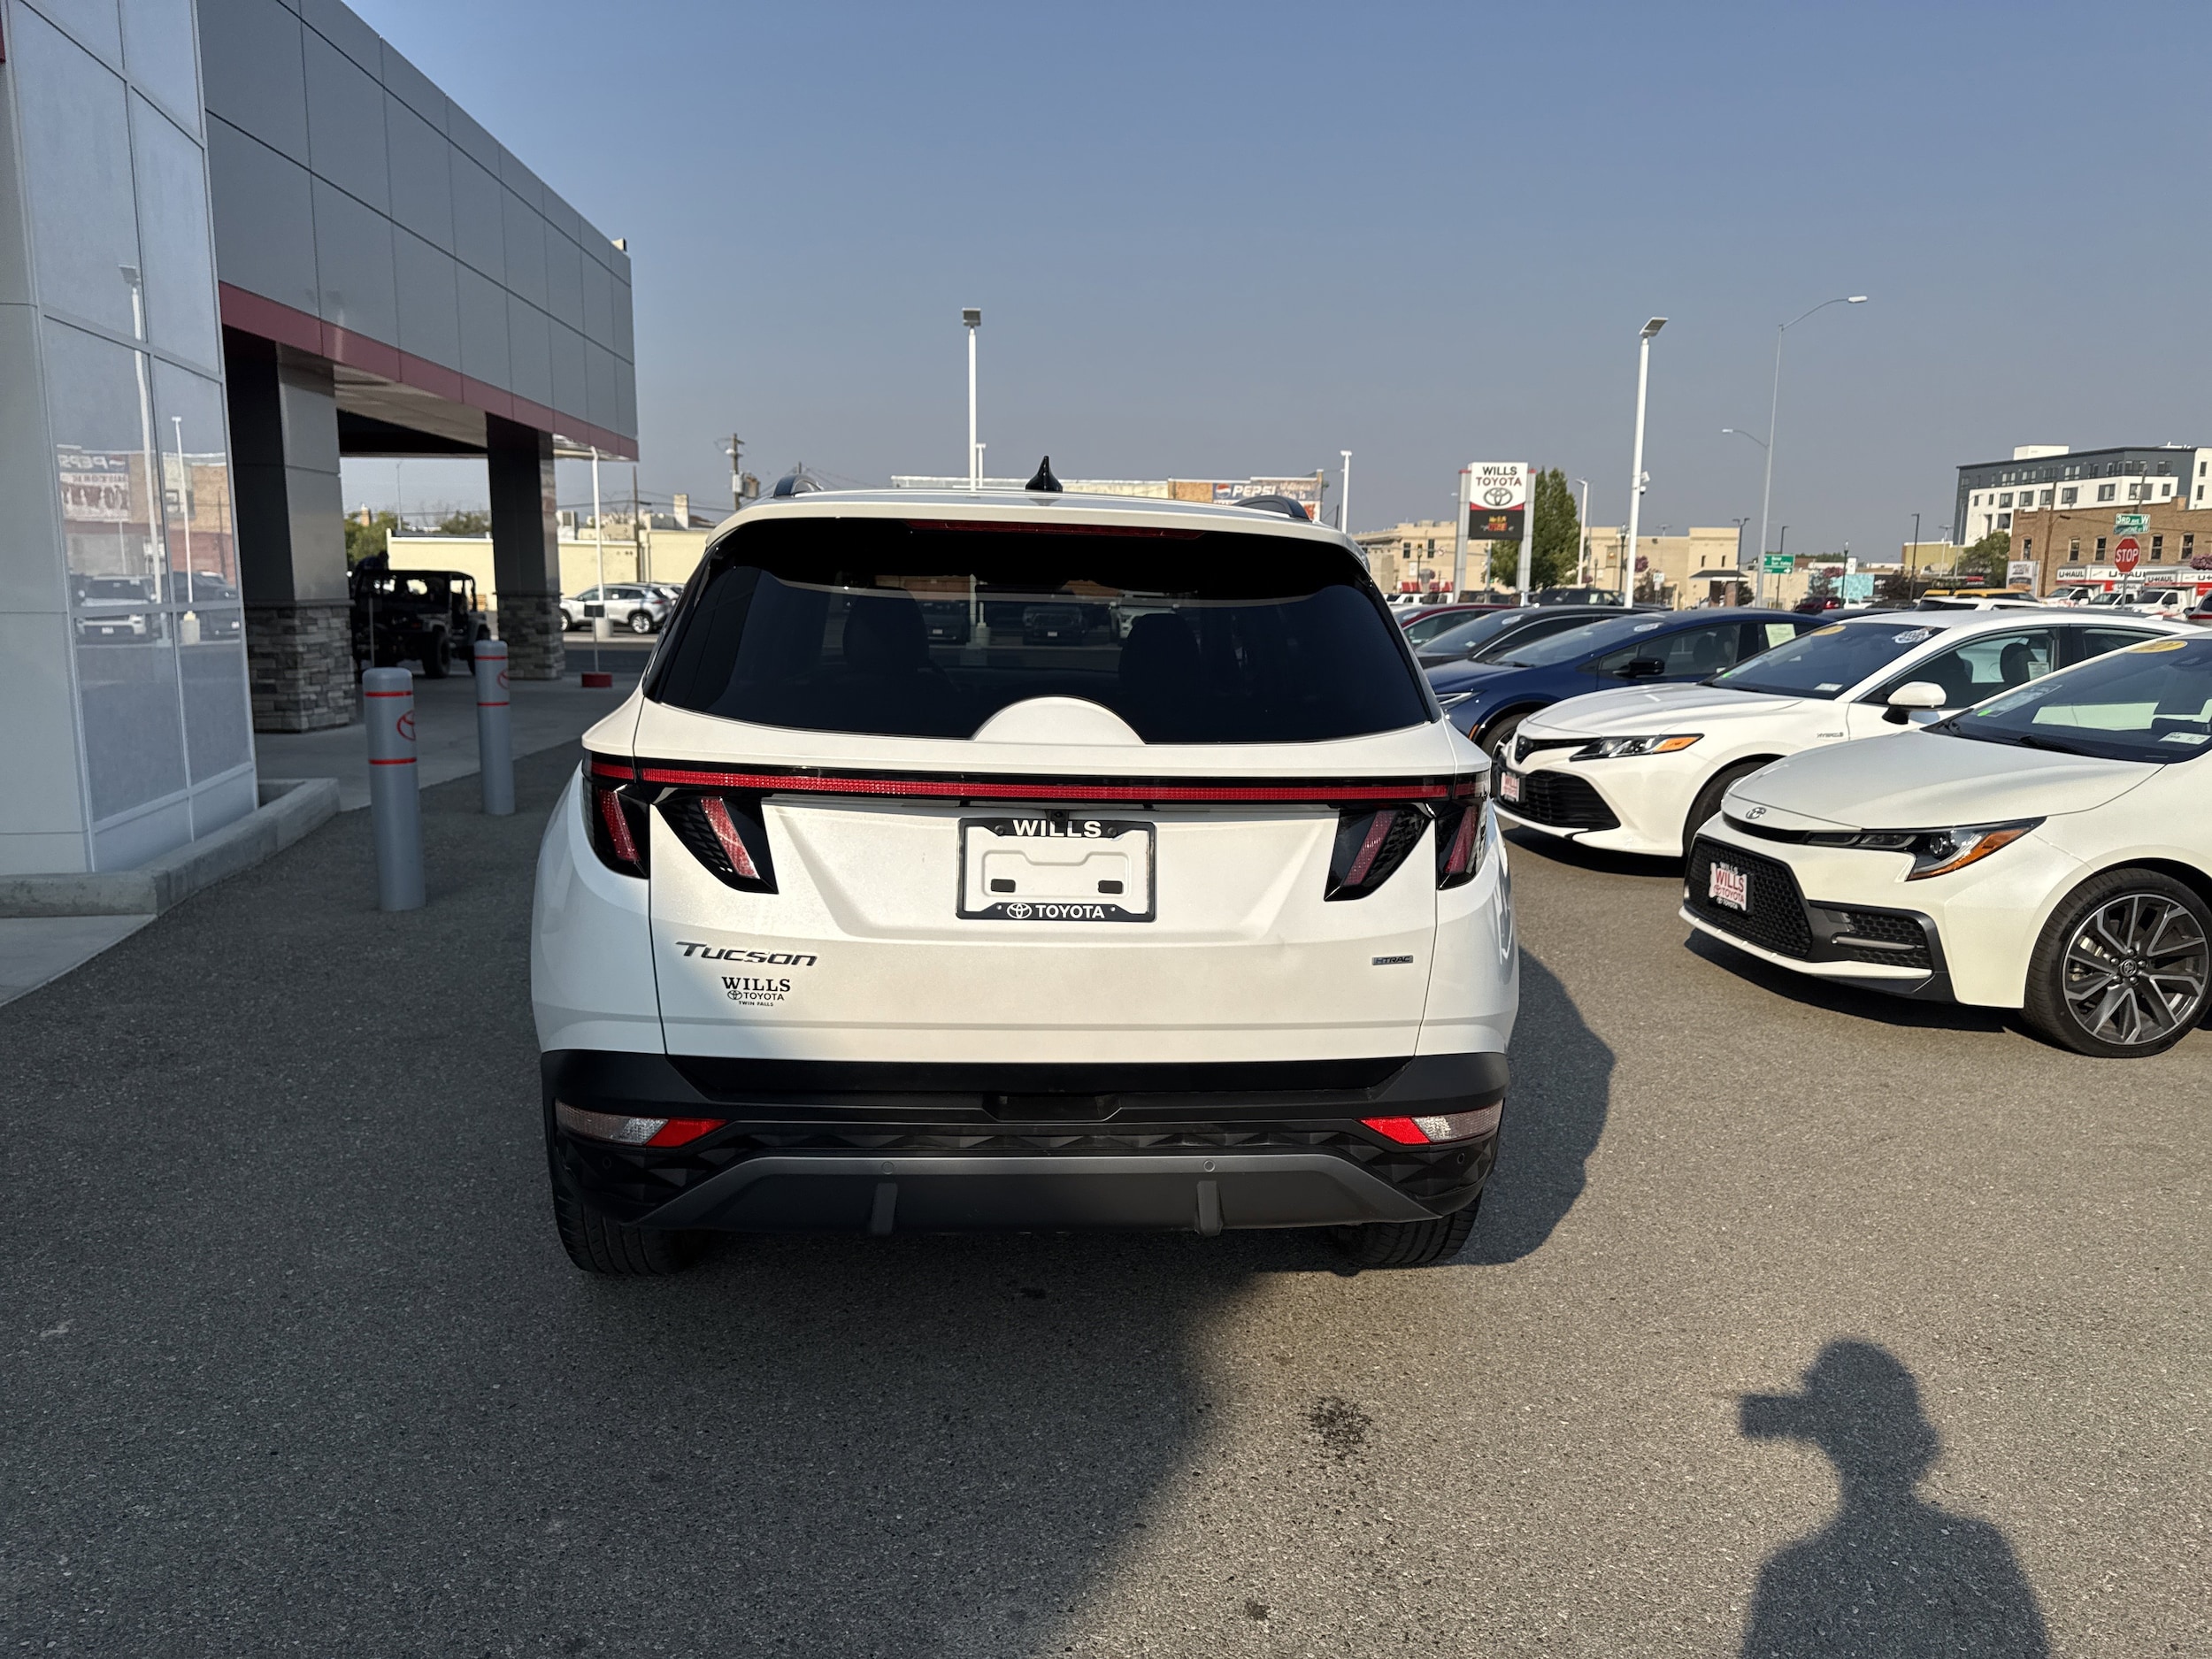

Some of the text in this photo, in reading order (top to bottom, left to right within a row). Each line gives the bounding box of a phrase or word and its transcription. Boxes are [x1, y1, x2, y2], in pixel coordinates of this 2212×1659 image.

[1483, 466, 1517, 476] WILLS
[1476, 477, 1522, 487] TOYOTA
[1233, 485, 1276, 497] PEPSI
[2141, 515, 2149, 524] W
[2116, 549, 2139, 563] STOP
[1012, 819, 1102, 838] WILLS
[1717, 870, 1744, 893] WILLS
[1722, 887, 1745, 903] TOYOTA
[1035, 904, 1105, 918] TOYOTA
[1375, 956, 1411, 964] HTRAC
[721, 976, 791, 993] WILLS
[743, 992, 785, 1001] TOYOTA
